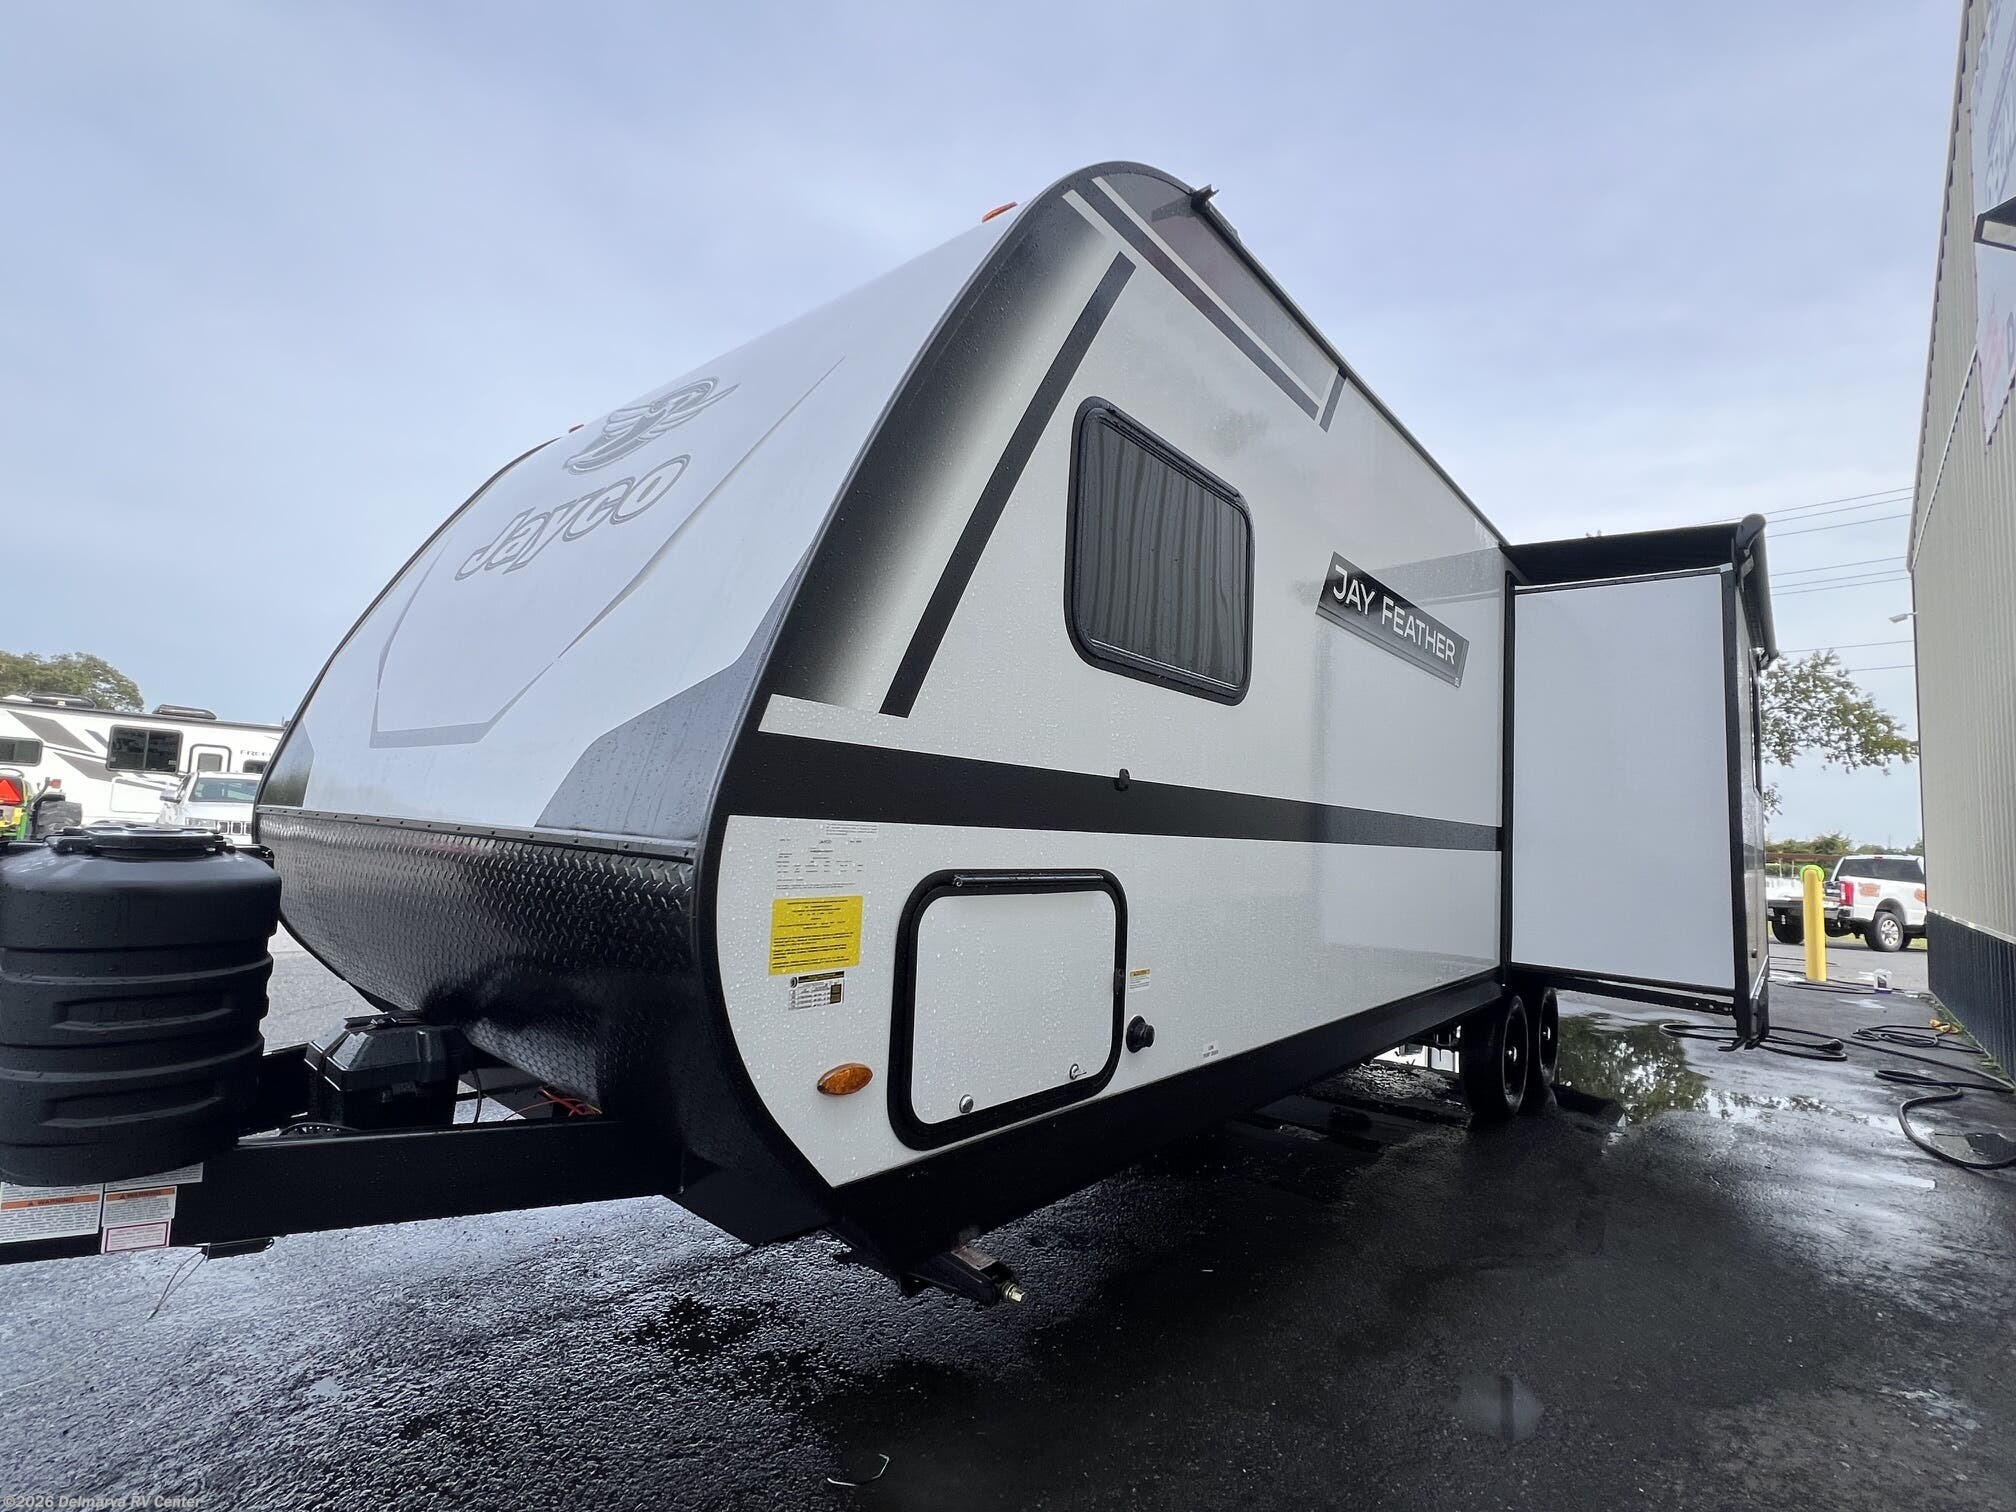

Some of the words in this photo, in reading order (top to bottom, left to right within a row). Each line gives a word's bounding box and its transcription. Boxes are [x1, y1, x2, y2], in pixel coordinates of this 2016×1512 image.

[1333, 564, 1376, 616] JAY
[1381, 595, 1456, 665] FEATHER
[37, 1196, 75, 1207] WARNING
